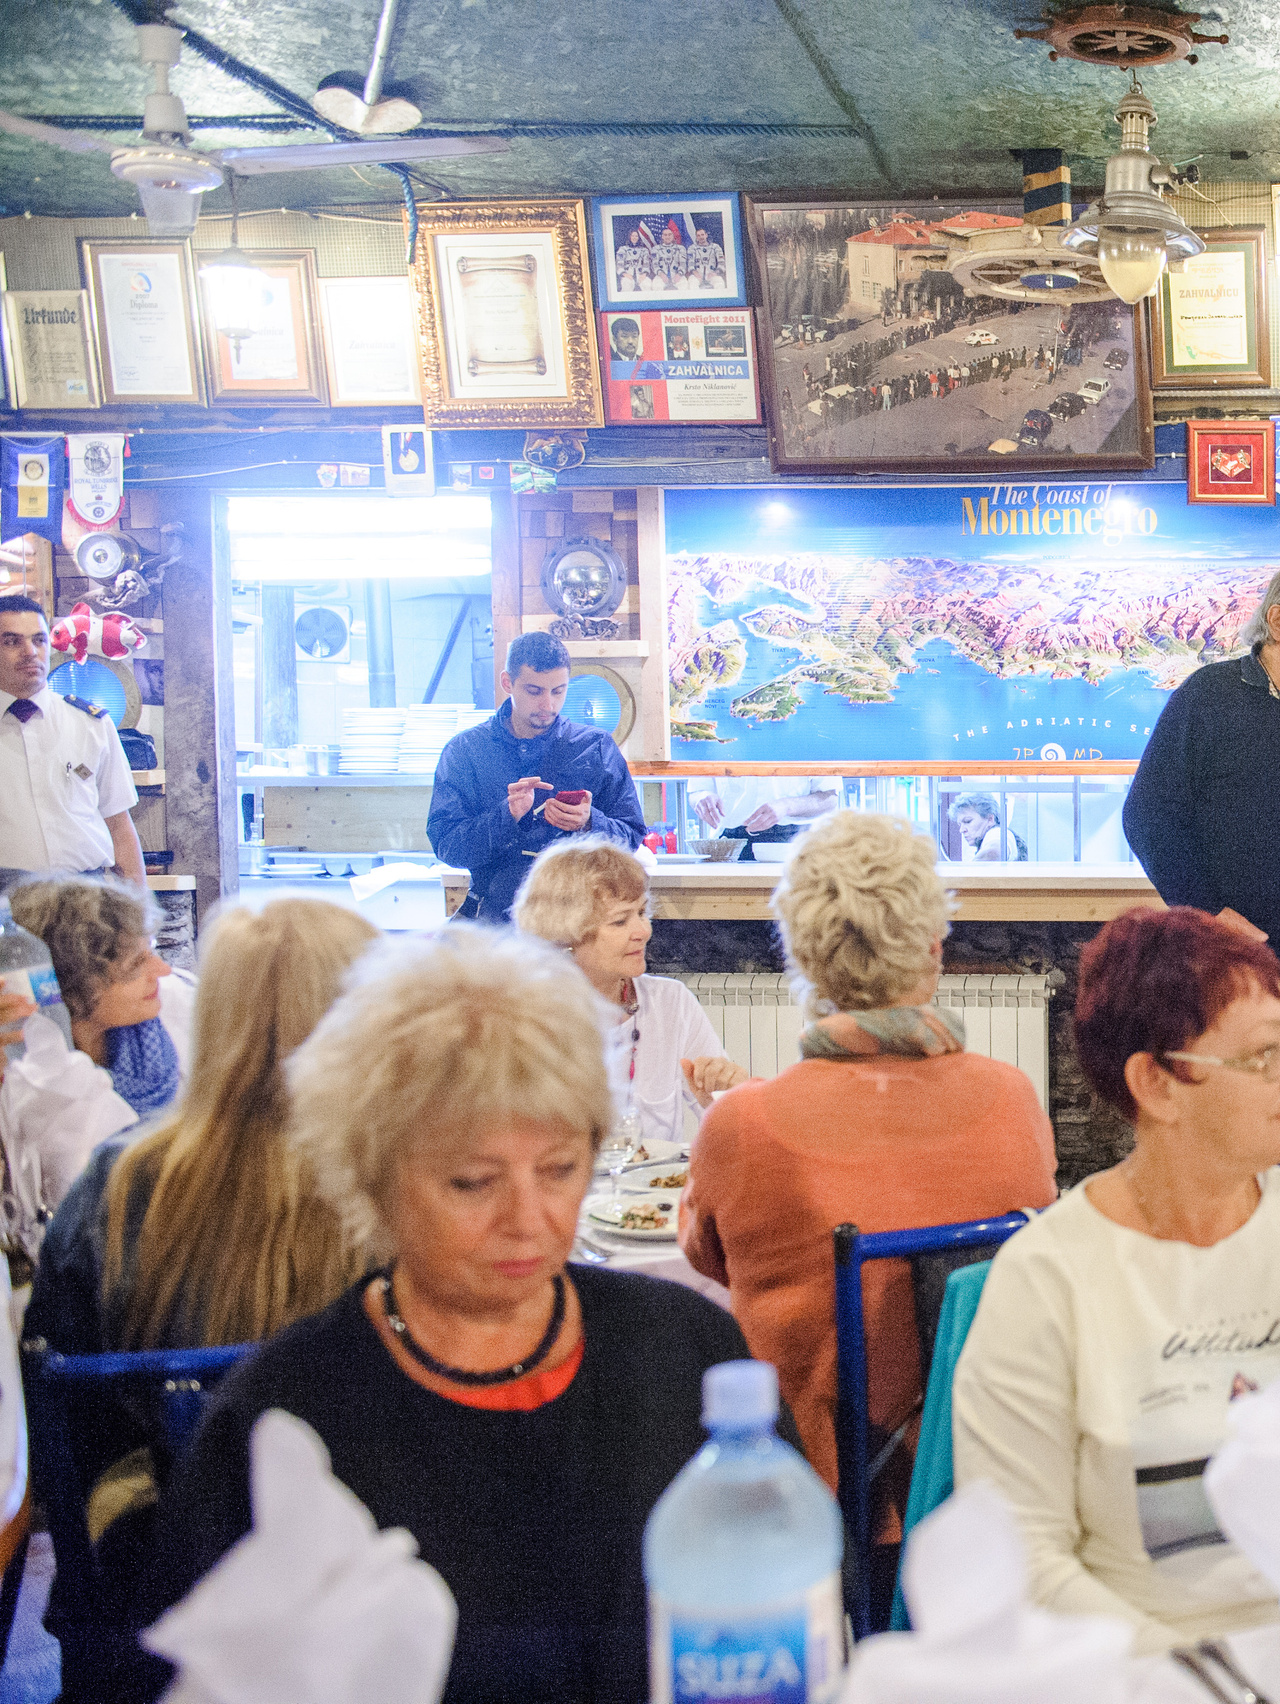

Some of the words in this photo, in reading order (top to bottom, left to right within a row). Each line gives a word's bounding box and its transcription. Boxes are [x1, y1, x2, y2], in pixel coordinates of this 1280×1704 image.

[1179, 288, 1239, 299] ZAHVALNICU
[130, 299, 158, 310] Diploma
[23, 306, 77, 325] Urkunde
[664, 315, 720, 324] Montefight
[722, 315, 746, 323] 2011
[668, 365, 744, 376] ZAHVALNICA
[988, 485, 1028, 505] The
[1032, 485, 1090, 505] Coast
[1092, 484, 1116, 511] of
[961, 496, 1158, 547] Montenegro
[953, 725, 988, 742] THE
[1006, 717, 1112, 729] ADRIATIC
[1130, 724, 1151, 736] SE
